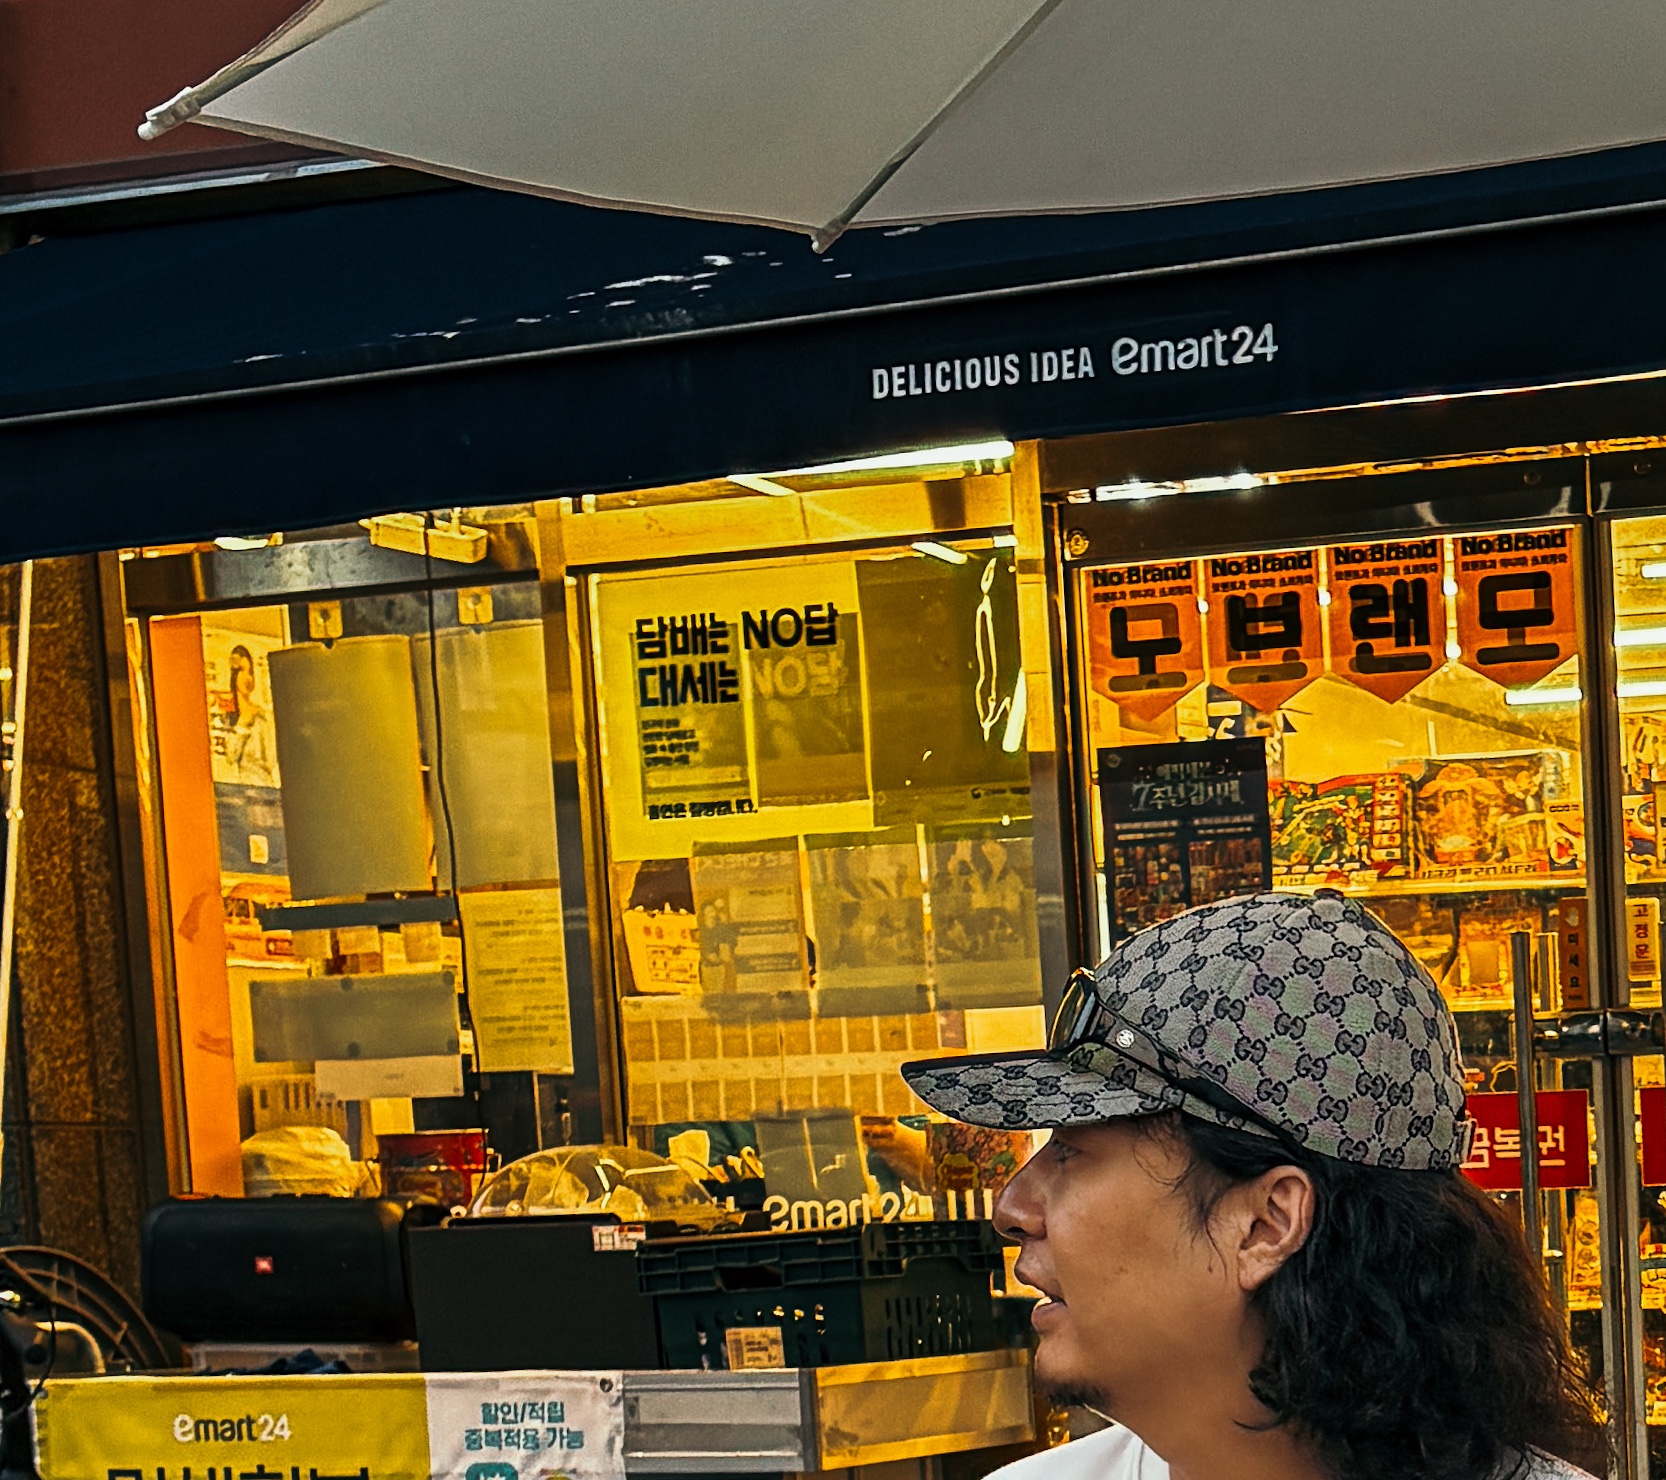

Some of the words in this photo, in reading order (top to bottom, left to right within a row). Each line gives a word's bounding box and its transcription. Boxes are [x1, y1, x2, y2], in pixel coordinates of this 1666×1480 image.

[872, 353, 1019, 400] DELICIOUS
[1030, 347, 1095, 382] IDEA
[1111, 323, 1279, 375] emart24
[636, 613, 729, 660] 담배는
[742, 602, 838, 649] NO답
[638, 661, 739, 707] 대세는
[1459, 1125, 1566, 1170] 금복권
[173, 1414, 292, 1442] emart24
